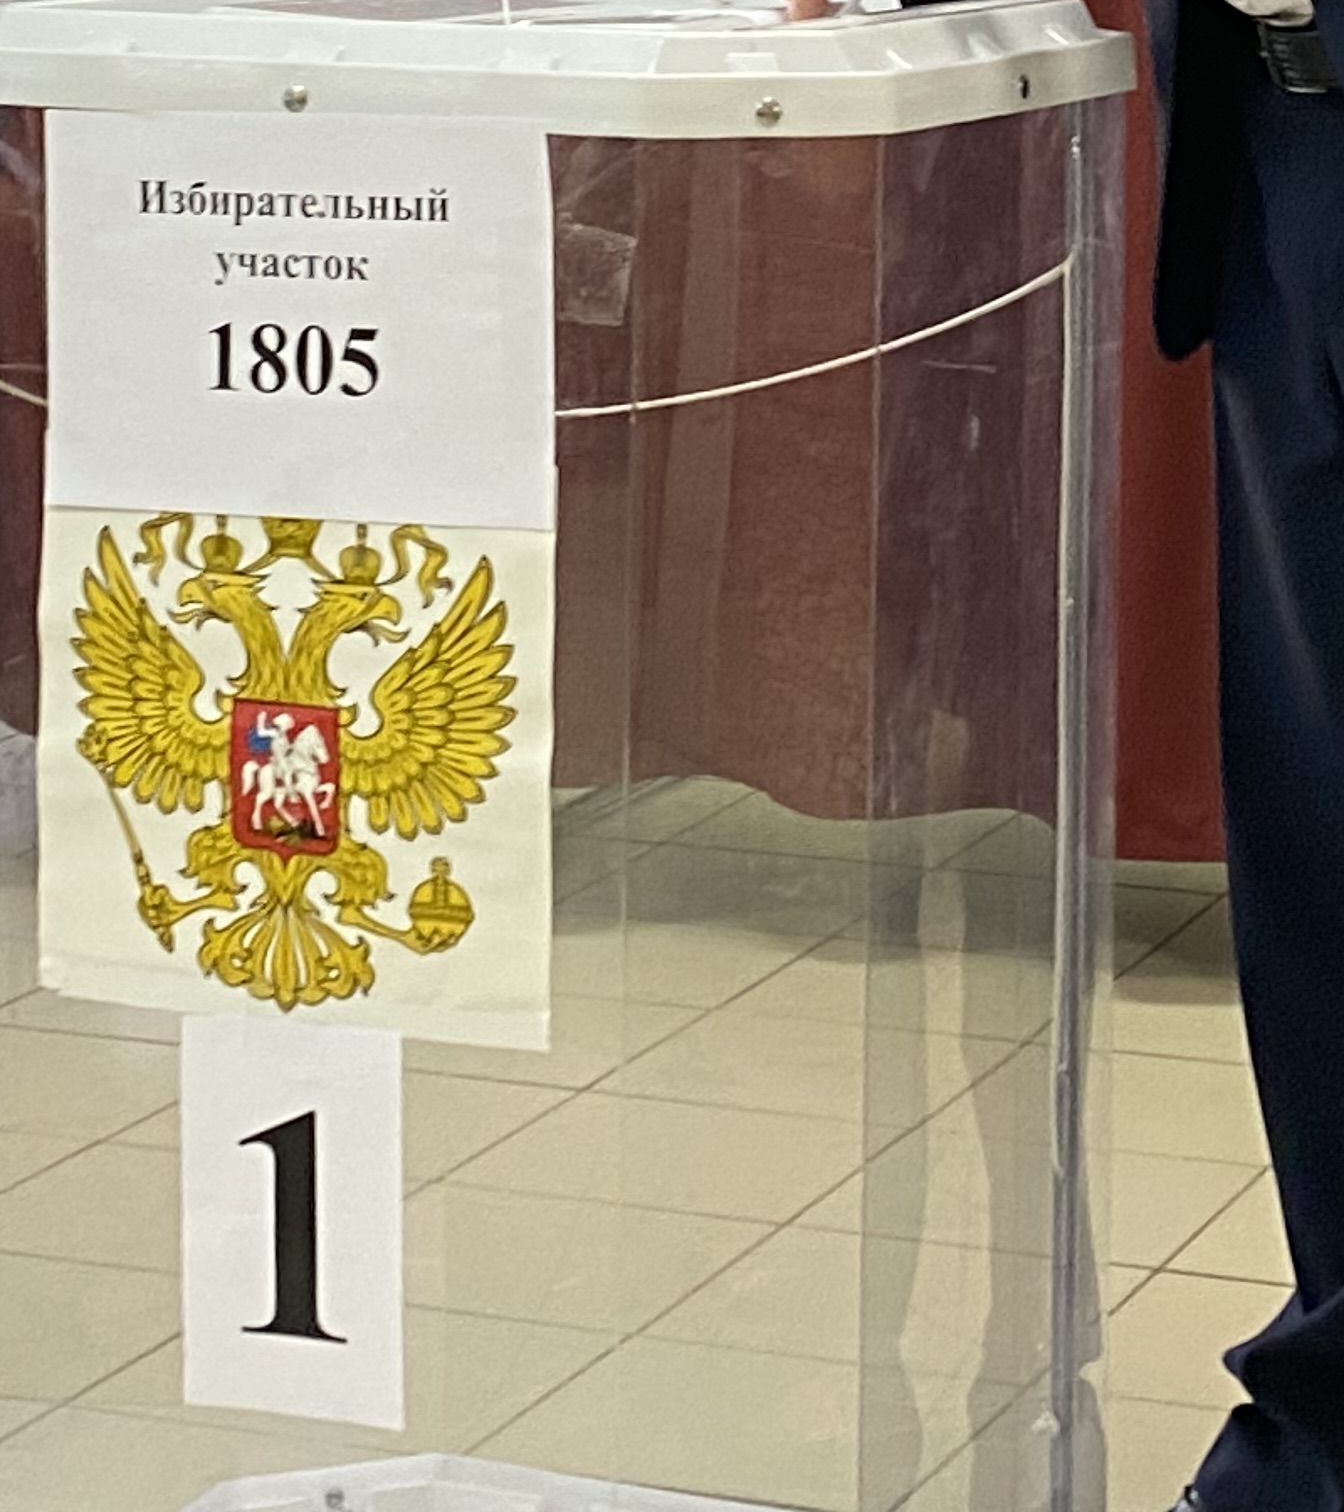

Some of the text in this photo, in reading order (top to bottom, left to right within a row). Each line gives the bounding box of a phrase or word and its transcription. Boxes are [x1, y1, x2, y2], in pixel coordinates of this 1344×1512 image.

[139, 180, 449, 226] Избирательный
[214, 250, 370, 285] участок
[208, 321, 380, 398] 1805
[237, 1109, 349, 1345] 1
